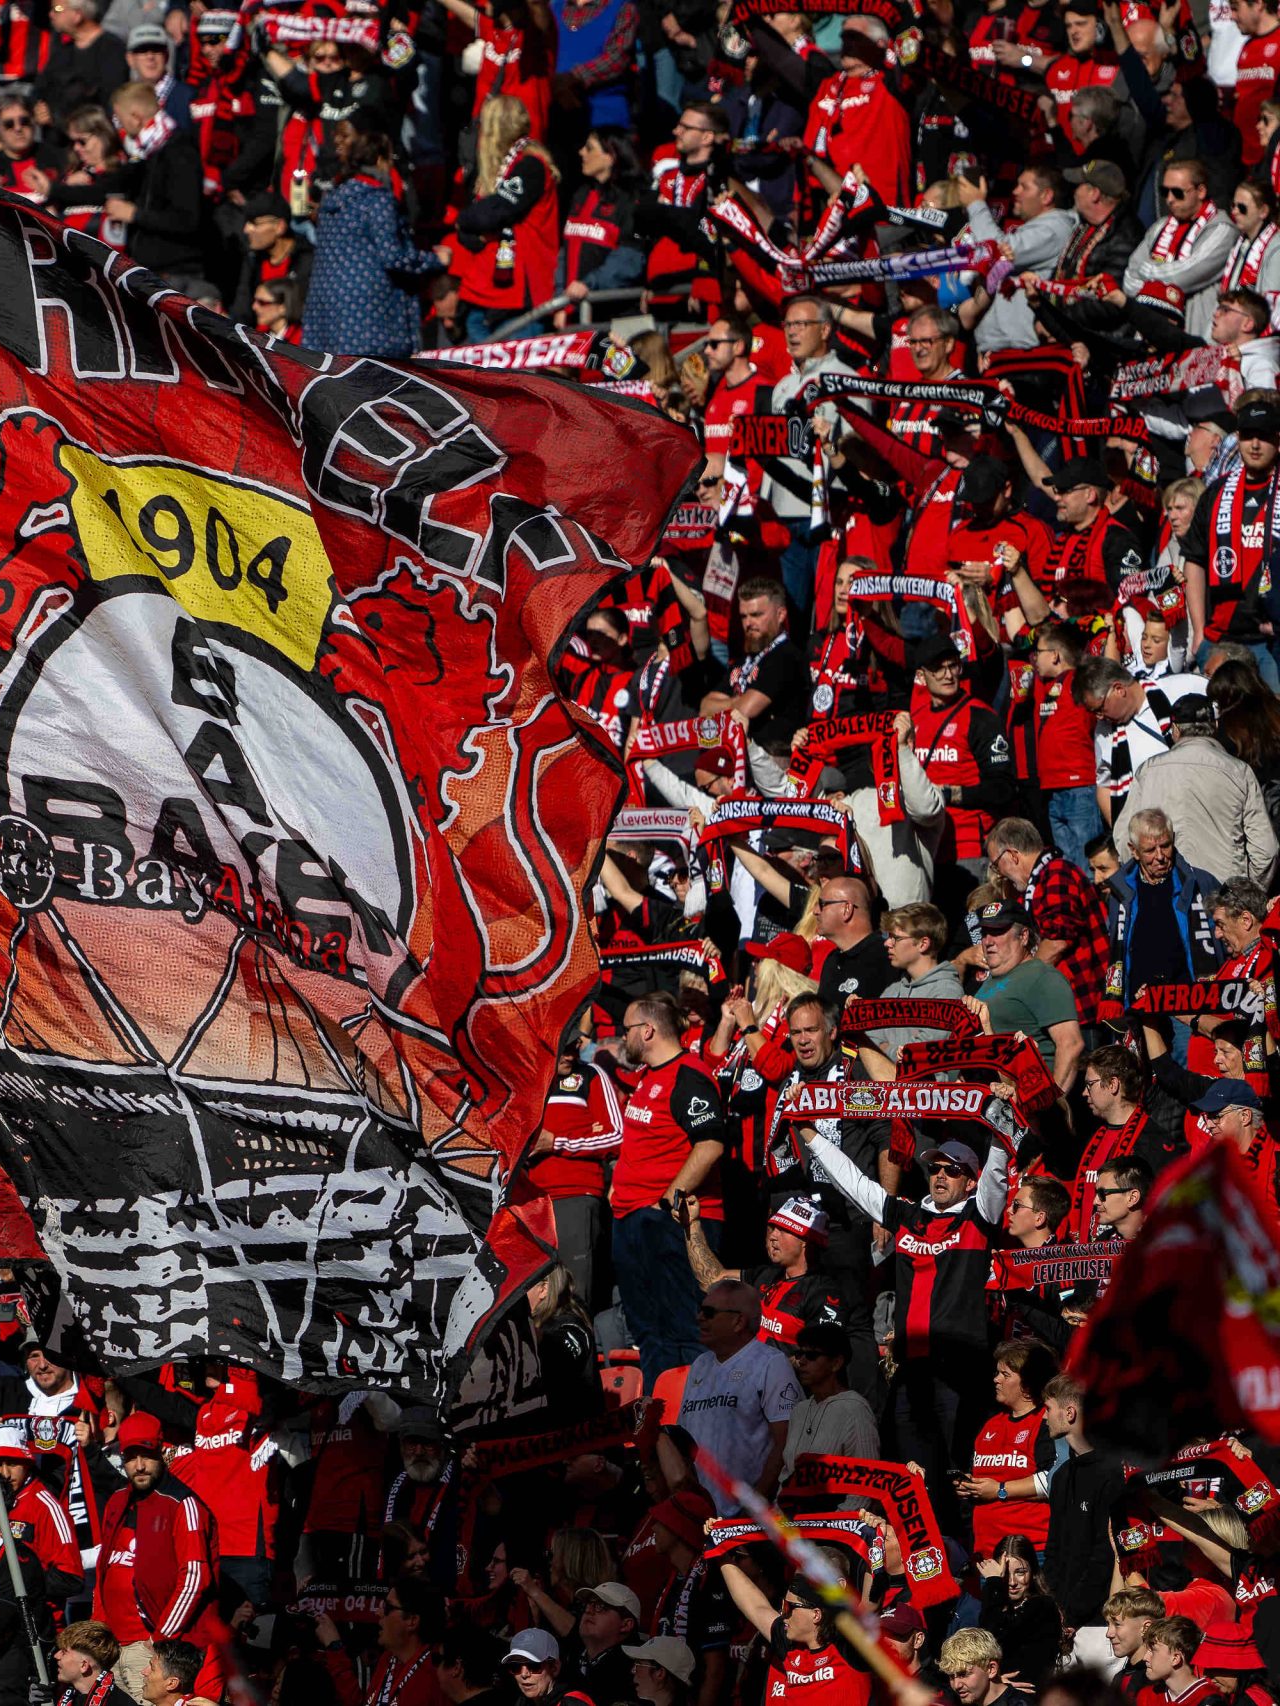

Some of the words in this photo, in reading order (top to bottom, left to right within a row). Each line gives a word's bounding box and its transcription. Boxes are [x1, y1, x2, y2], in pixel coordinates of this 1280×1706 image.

[732, 415, 788, 458] BAYER
[98, 487, 293, 614] 1904
[893, 574, 933, 596] UNTERM
[621, 809, 687, 827] Leverkusen
[886, 1089, 983, 1111] ALONSO
[690, 1111, 717, 1129] NIEDAX
[1011, 1246, 1065, 1267] DEUTSCHER
[1065, 1243, 1105, 1259] MEISTER
[1033, 1259, 1112, 1286] LEVERKUSEN
[682, 1392, 739, 1415] Barmenia
[354, 1584, 389, 1594] adidas
[344, 1595, 366, 1612] 04
